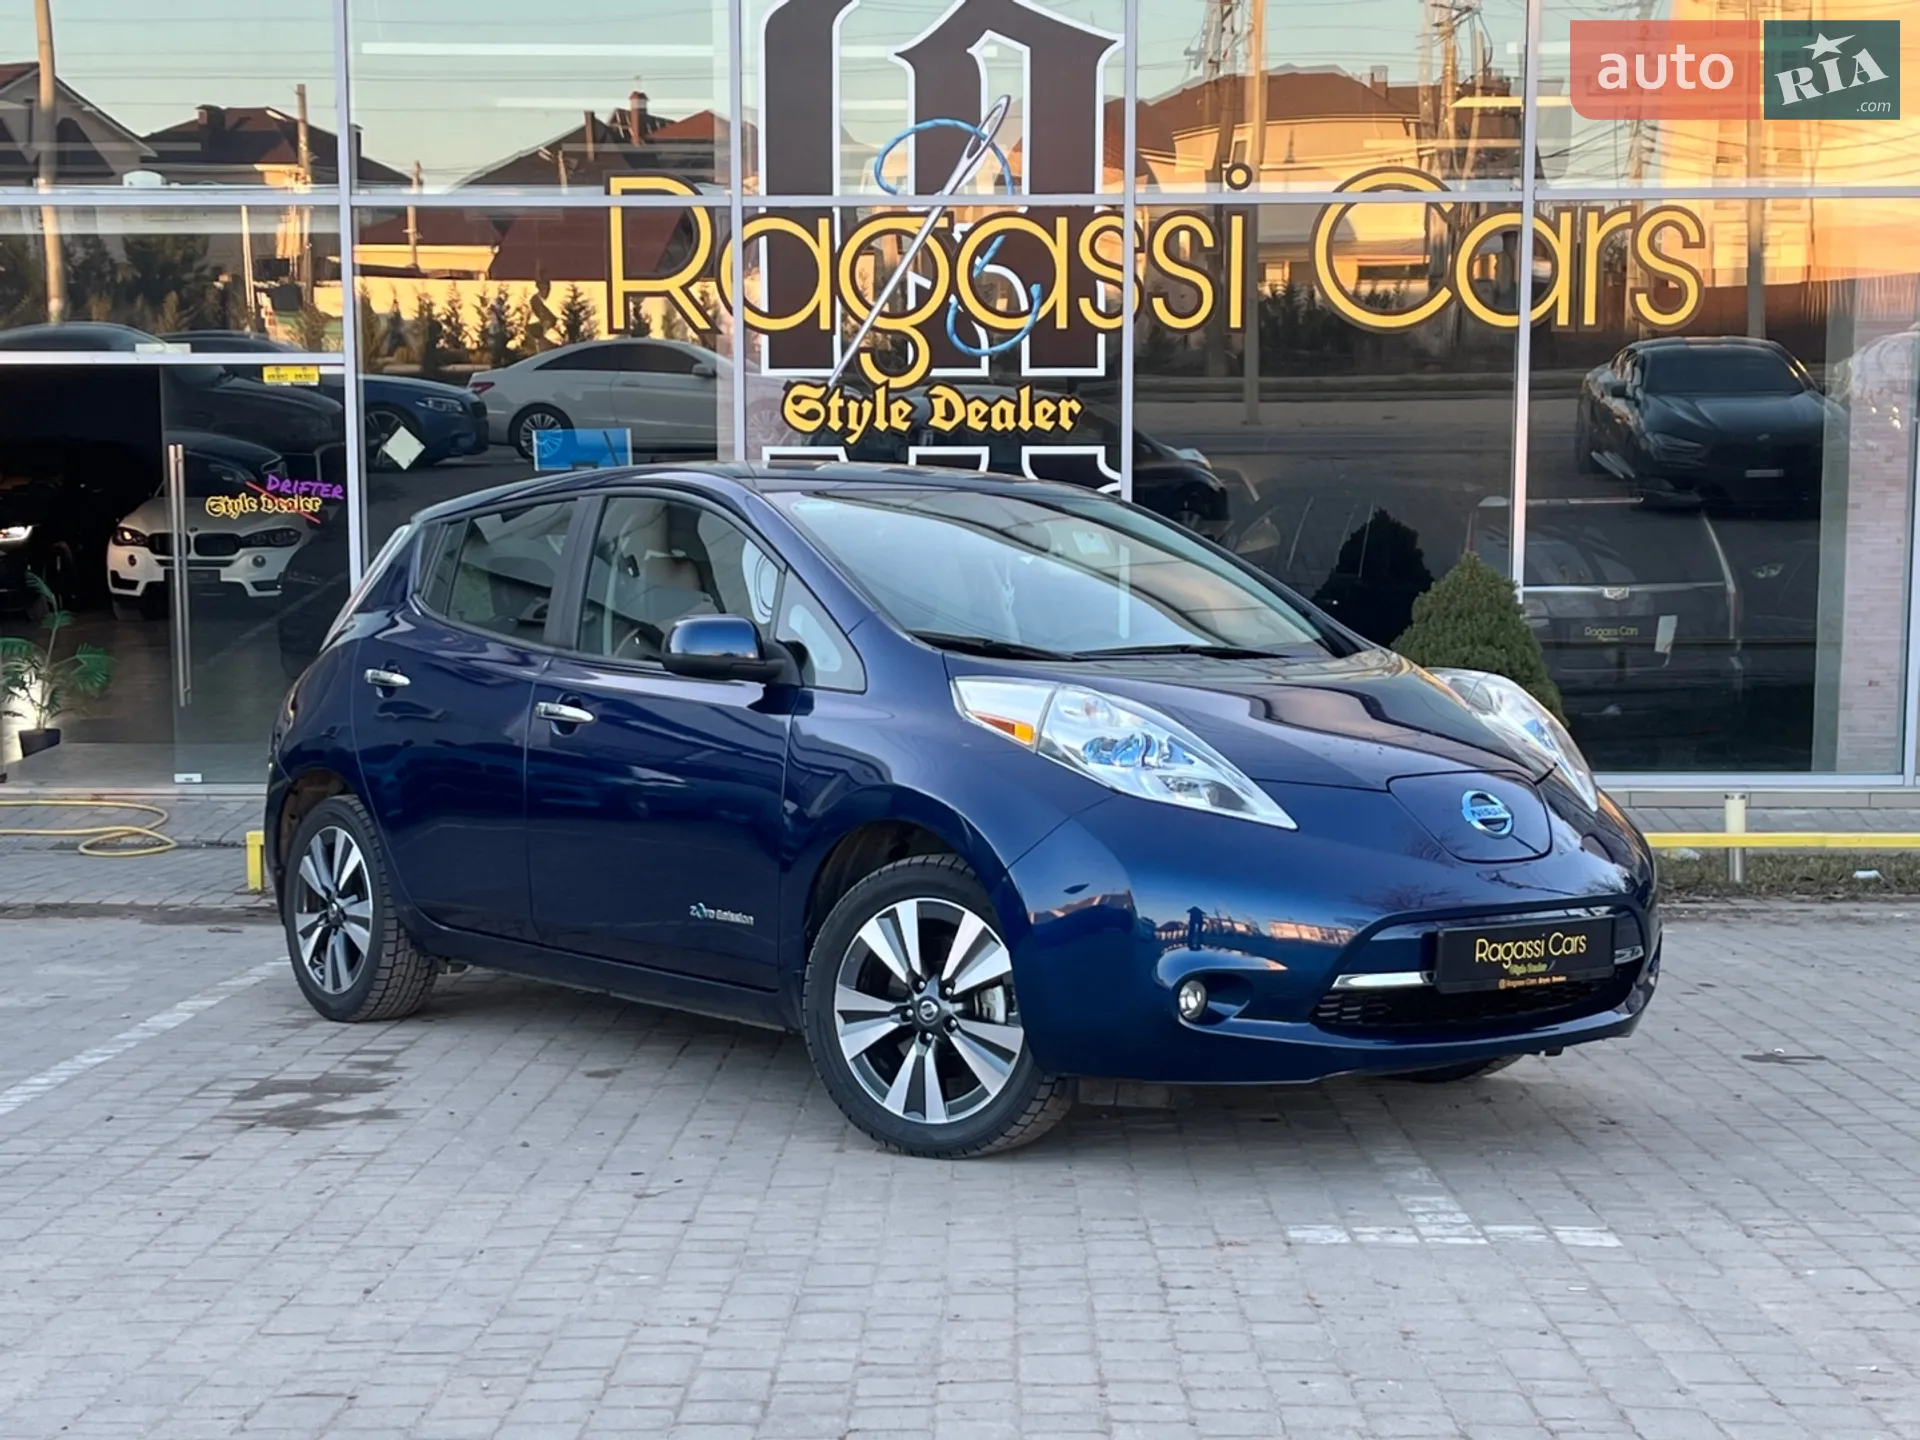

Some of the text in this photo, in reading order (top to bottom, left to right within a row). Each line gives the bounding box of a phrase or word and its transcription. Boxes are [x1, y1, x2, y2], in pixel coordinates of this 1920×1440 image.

[604, 163, 1706, 392] Ragassi Cars
[782, 384, 1083, 445] Style Dealer
[205, 492, 259, 519] Style
[266, 475, 345, 500] DRIFTER
[1475, 933, 1545, 969] Ragassi
[1547, 931, 1587, 956] Cars
